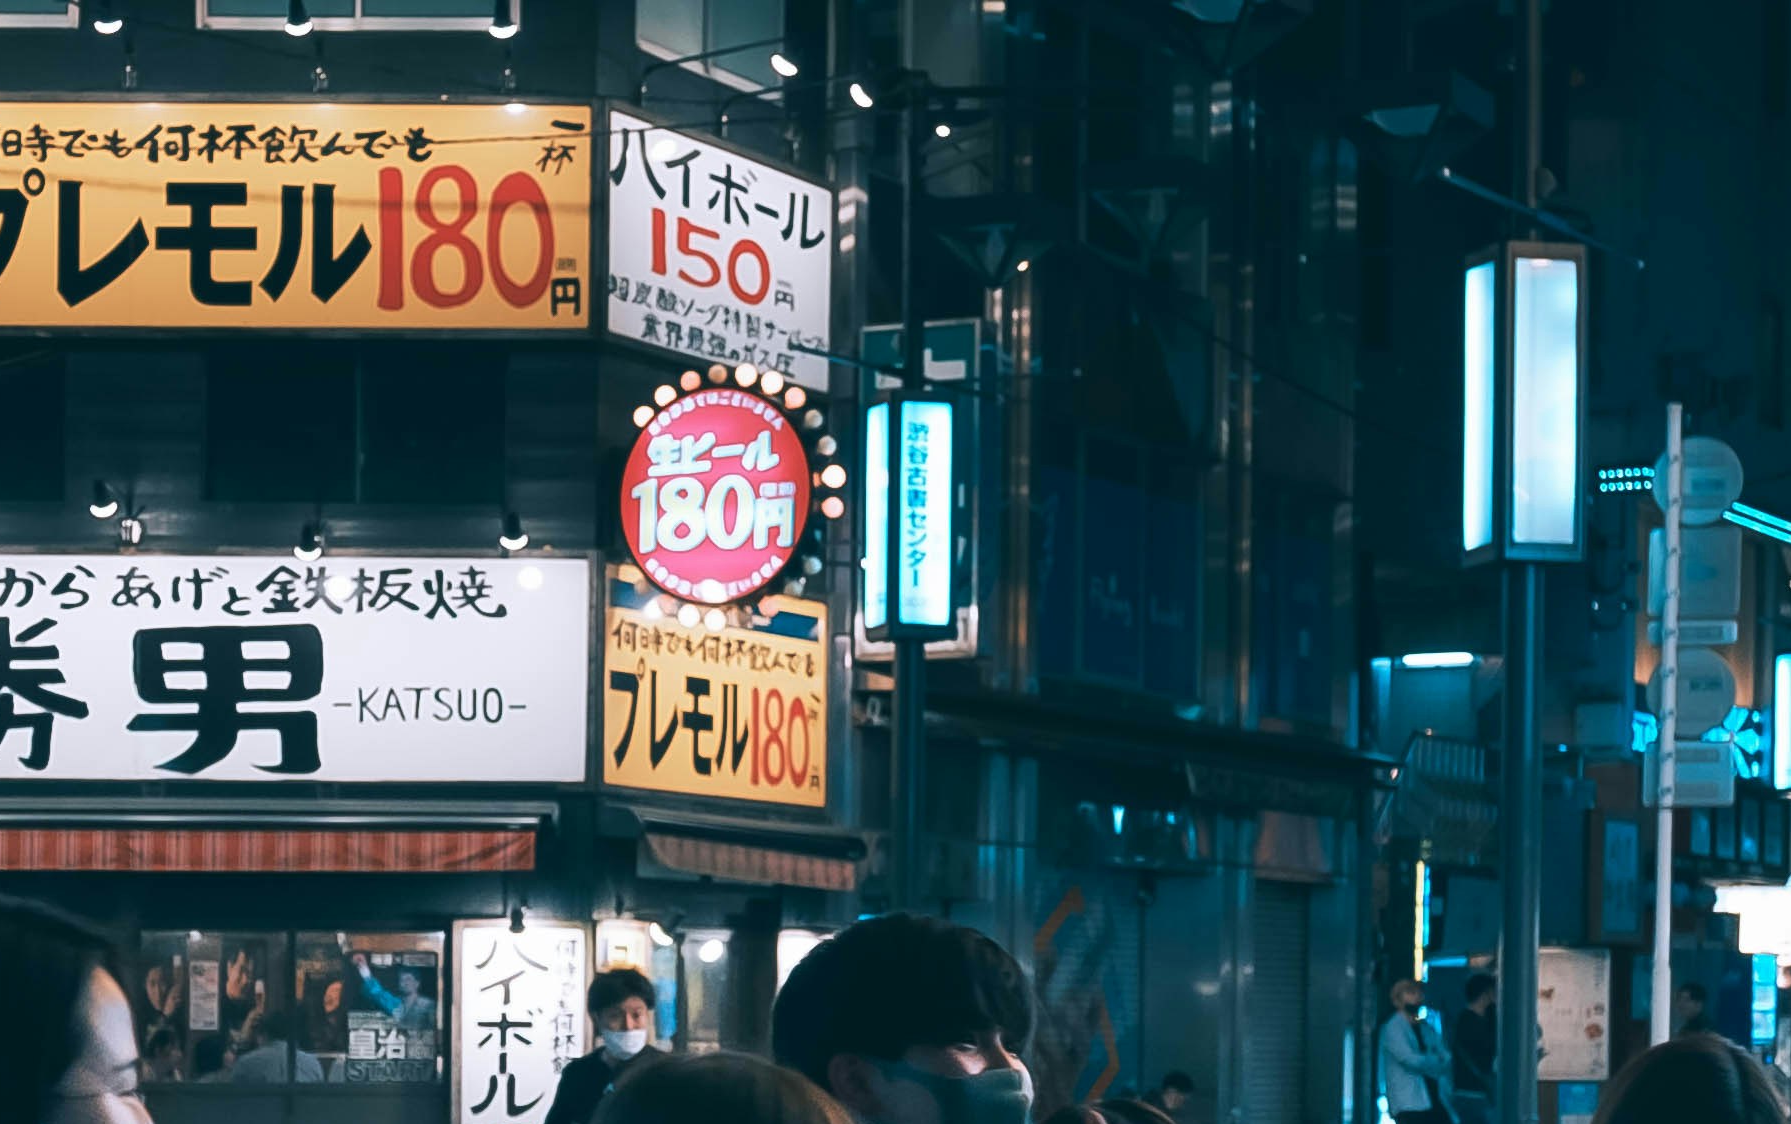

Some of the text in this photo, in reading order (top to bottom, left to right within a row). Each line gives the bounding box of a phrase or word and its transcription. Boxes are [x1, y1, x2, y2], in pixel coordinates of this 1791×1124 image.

[610, 128, 825, 249] ハイボール
[647, 430, 780, 477] 生ビール
[905, 421, 929, 588] 渋谷古書センター
[630, 474, 796, 554] 180円
[610, 657, 749, 776] プレモル
[471, 939, 549, 1116] ハイボール
